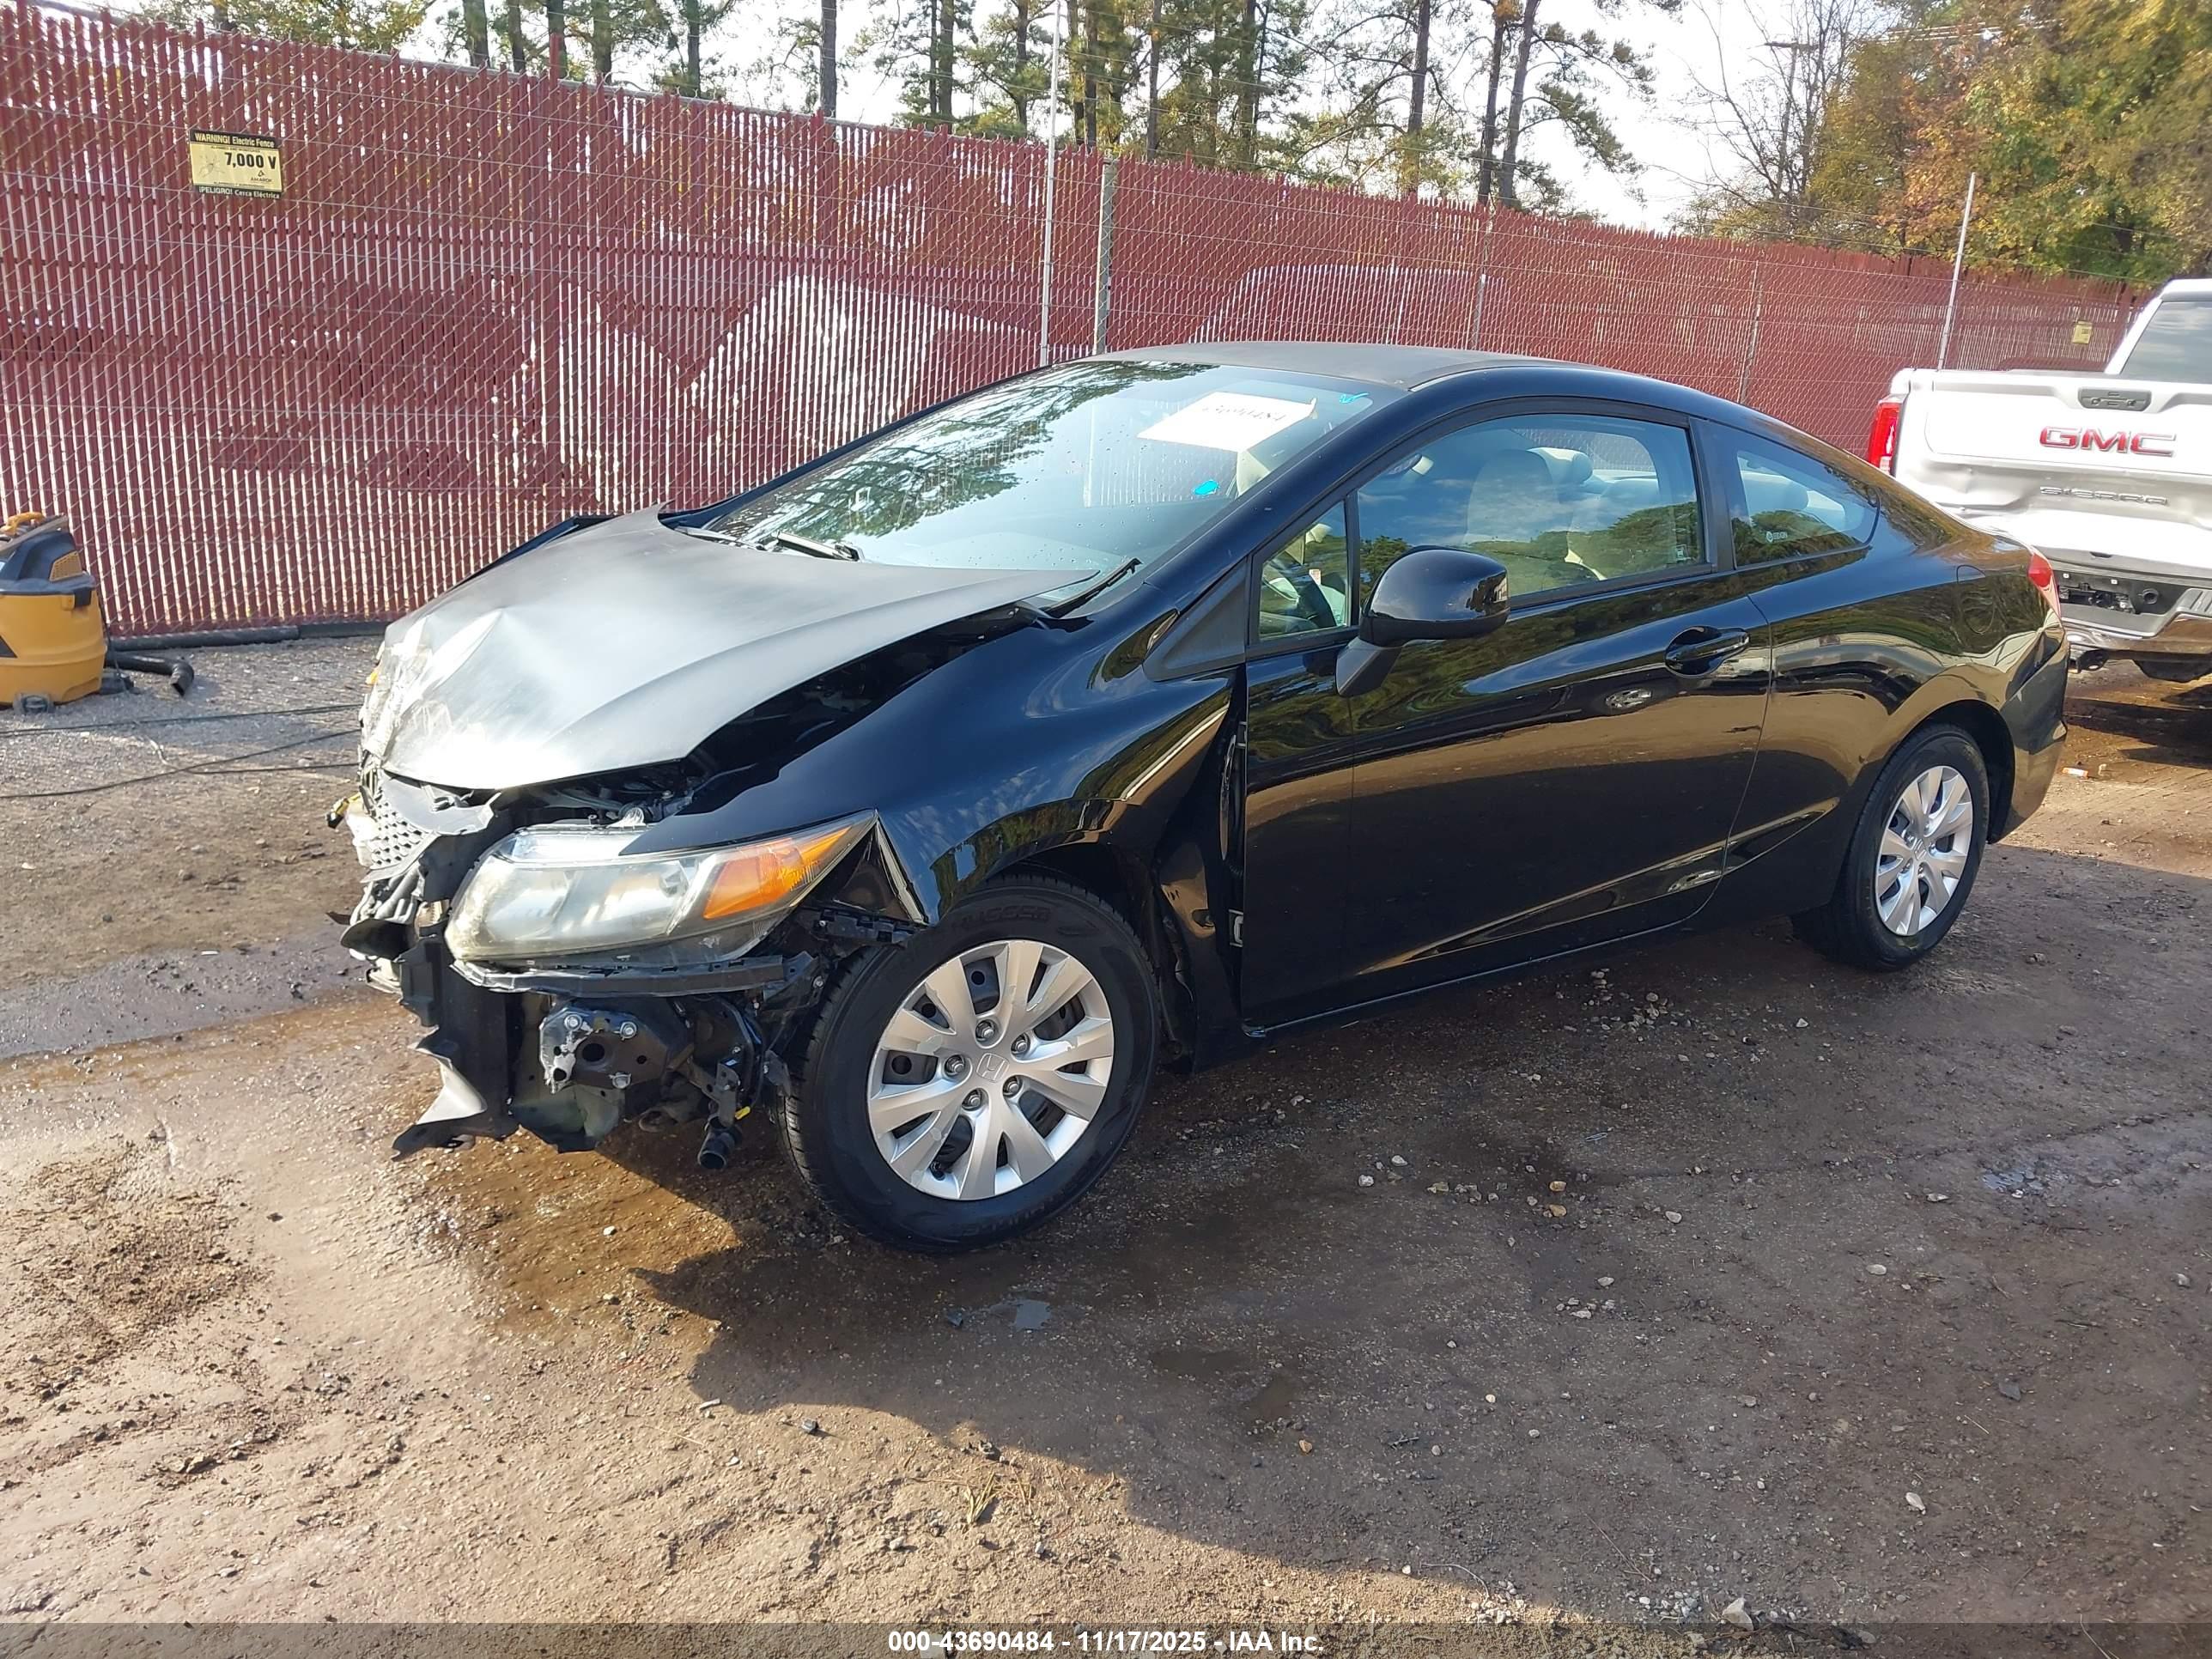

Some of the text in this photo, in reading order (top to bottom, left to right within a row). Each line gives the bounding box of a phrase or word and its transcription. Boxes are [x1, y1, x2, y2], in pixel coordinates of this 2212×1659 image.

[194, 132, 275, 148] WARNING! Electric Fence
[224, 152, 276, 169] 7,000 V
[253, 191, 280, 199] Eléctrica
[2039, 426, 2176, 458] GMC
[2039, 486, 2168, 506] SIERRA
